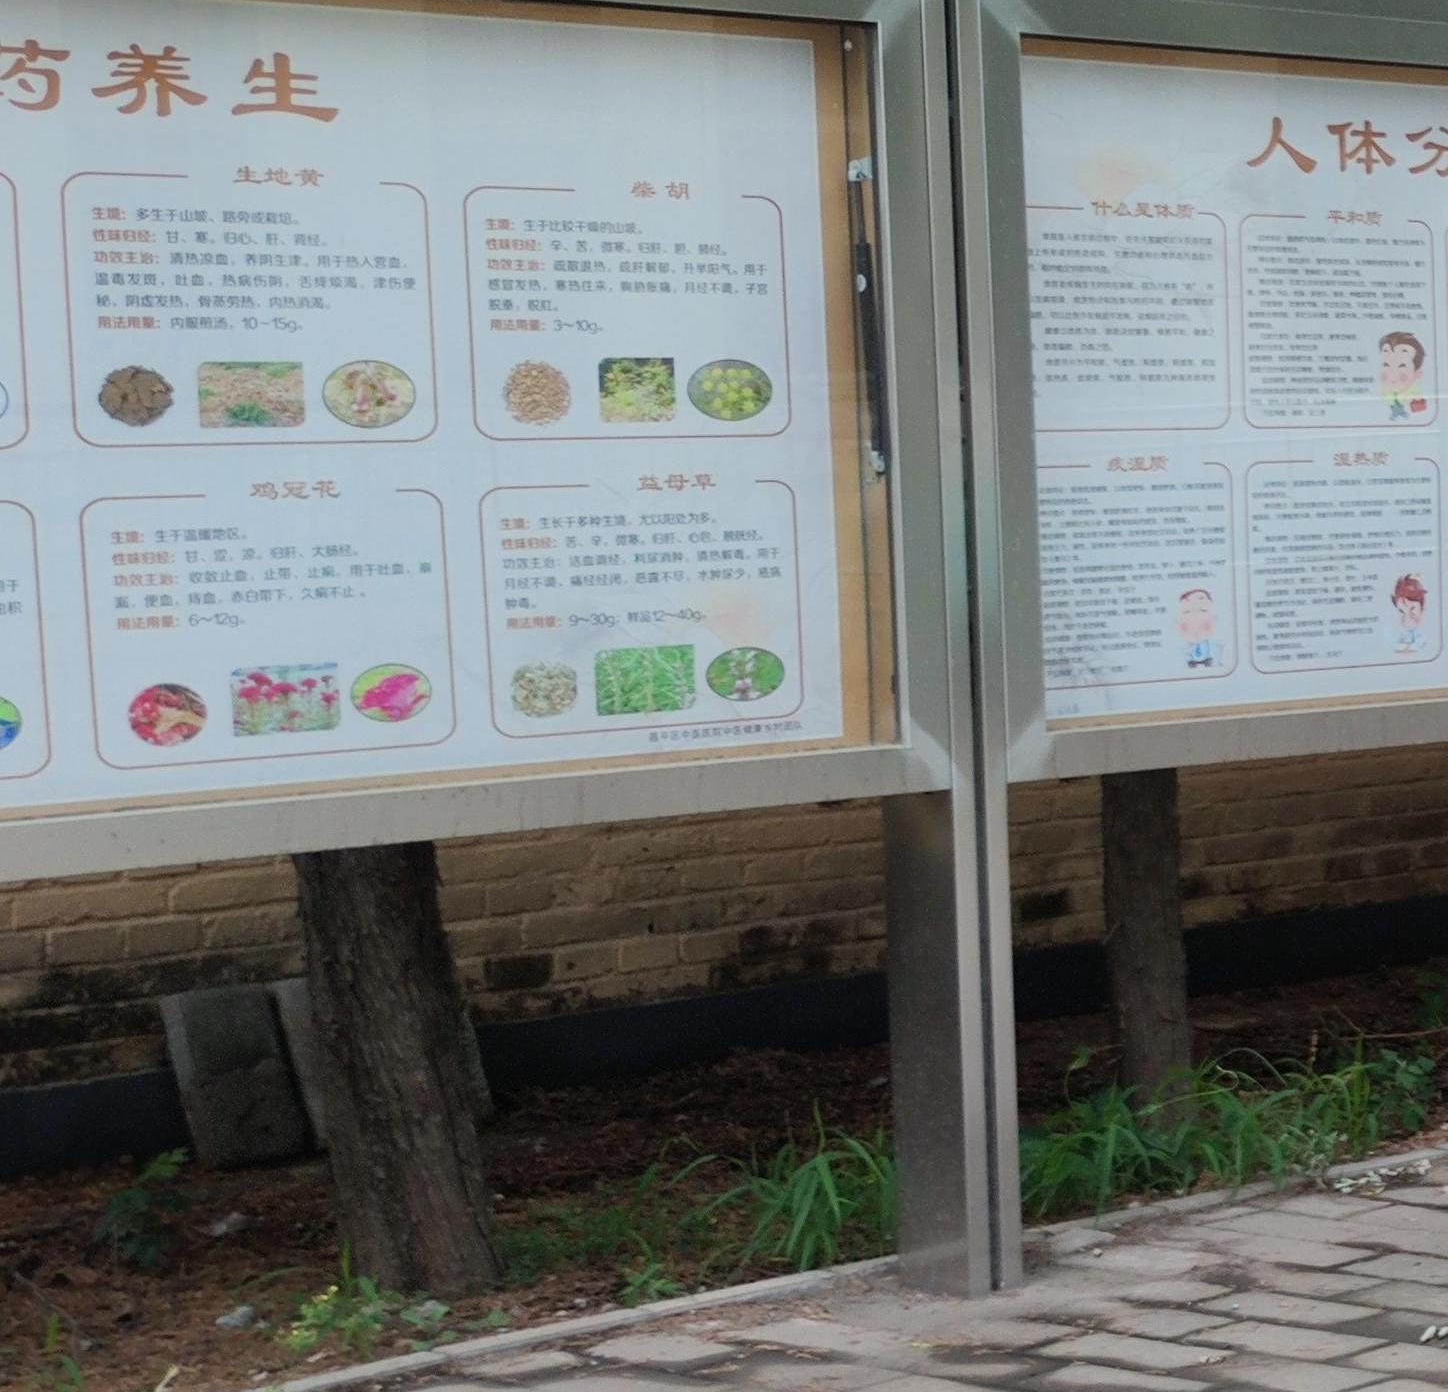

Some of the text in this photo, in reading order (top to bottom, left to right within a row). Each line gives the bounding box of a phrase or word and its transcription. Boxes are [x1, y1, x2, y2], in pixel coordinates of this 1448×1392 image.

[233, 166, 324, 187] 生地黄
[631, 181, 689, 200] 柴胡
[1091, 200, 1195, 218] 什么是体质
[250, 480, 340, 499] 鸡冠花
[637, 473, 717, 491] 益母草
